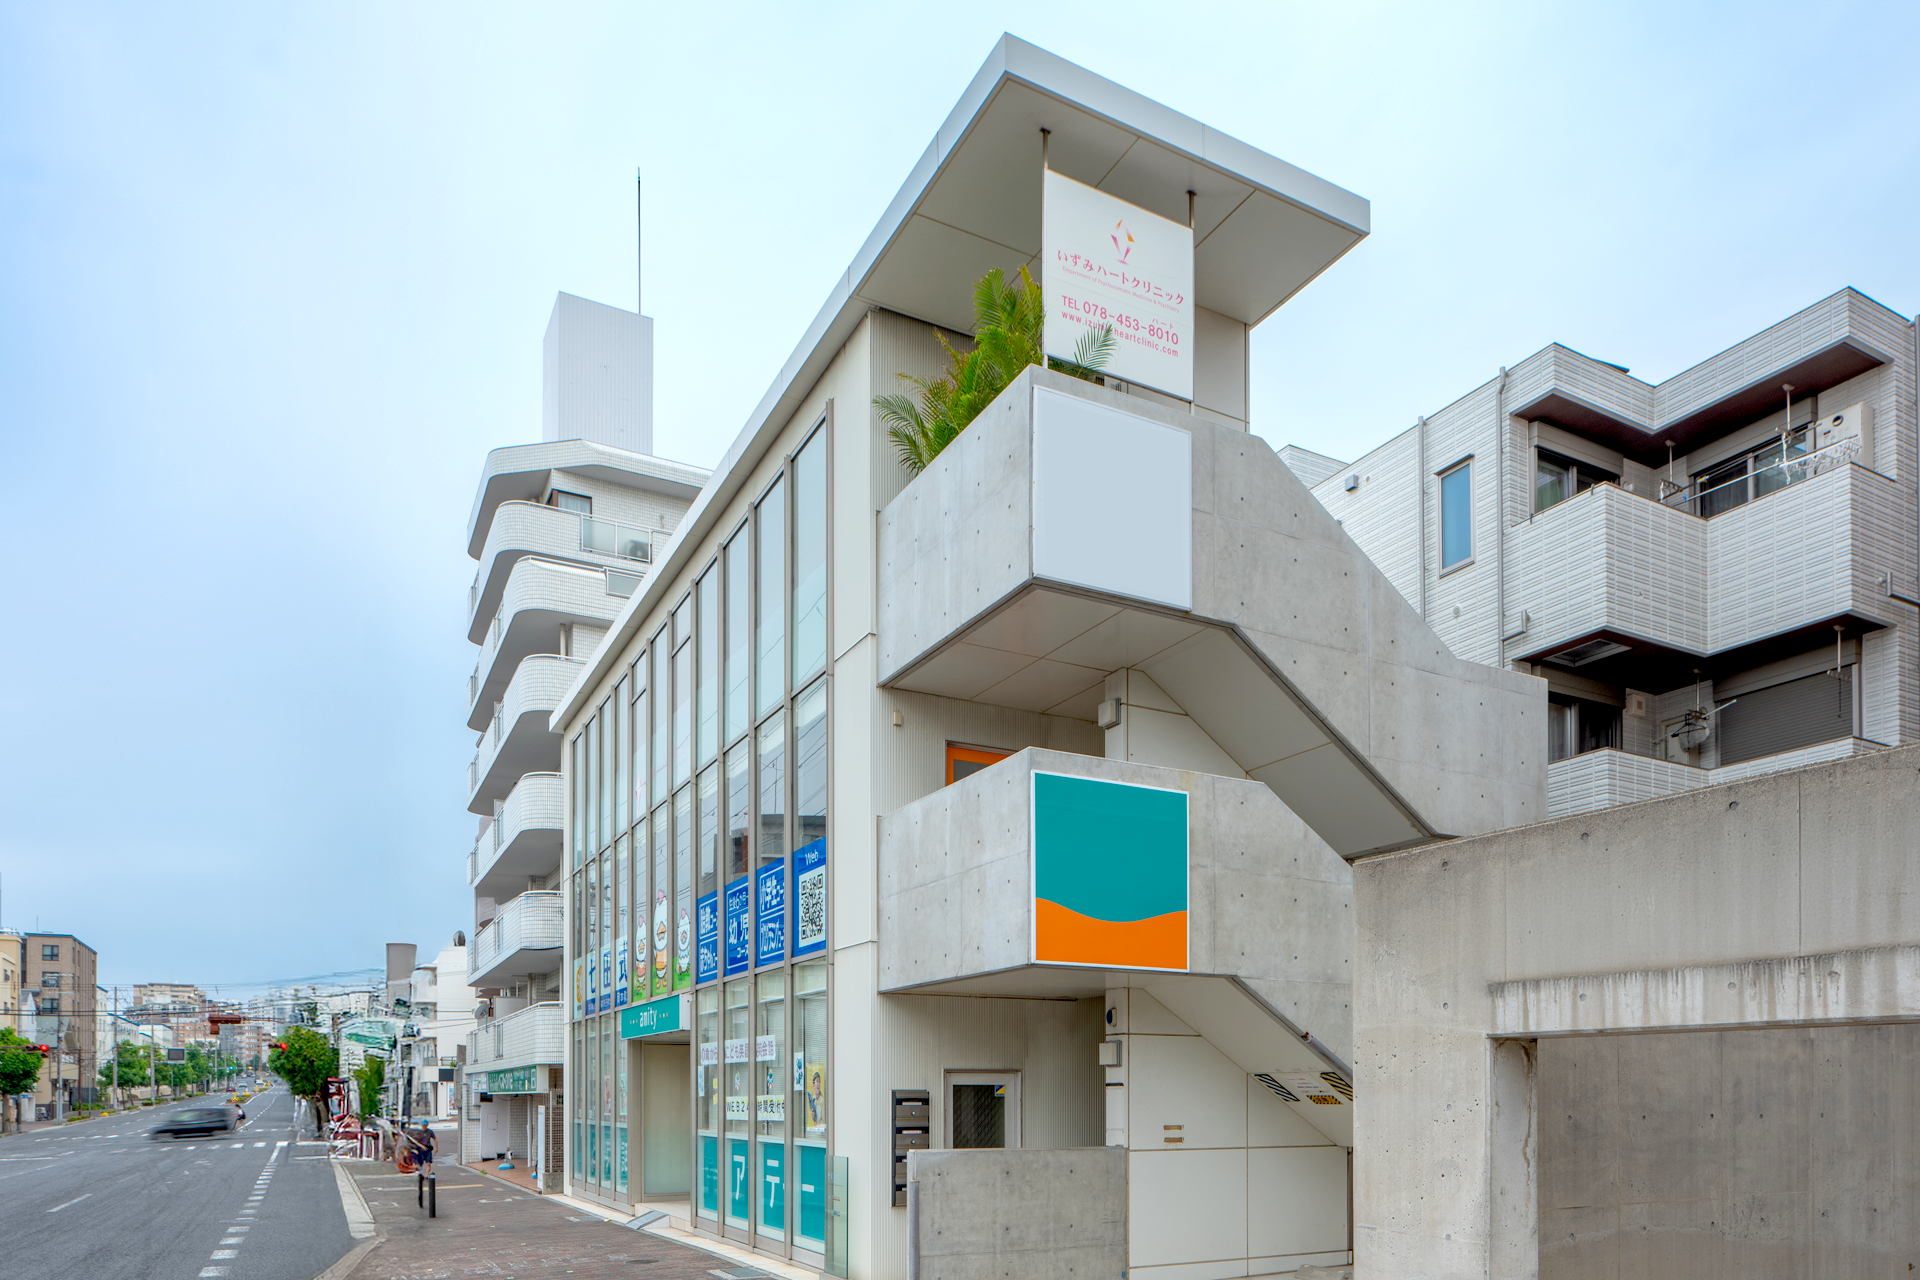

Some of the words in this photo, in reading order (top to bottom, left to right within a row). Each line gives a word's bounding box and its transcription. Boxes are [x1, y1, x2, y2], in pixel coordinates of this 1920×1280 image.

[1057, 249, 1184, 305] いずみハートクリニック
[1062, 266, 1091, 281] Department
[1097, 278, 1131, 296] Psychosomatic
[1132, 290, 1153, 303] Medicine
[1157, 300, 1180, 314] Psychiatry
[1061, 294, 1080, 312] TEL
[1083, 301, 1179, 346] 078-453-8010
[1151, 318, 1174, 330] ハート
[805, 849, 819, 866] Web
[728, 912, 748, 945] 幼児
[639, 1006, 657, 1030] amity
